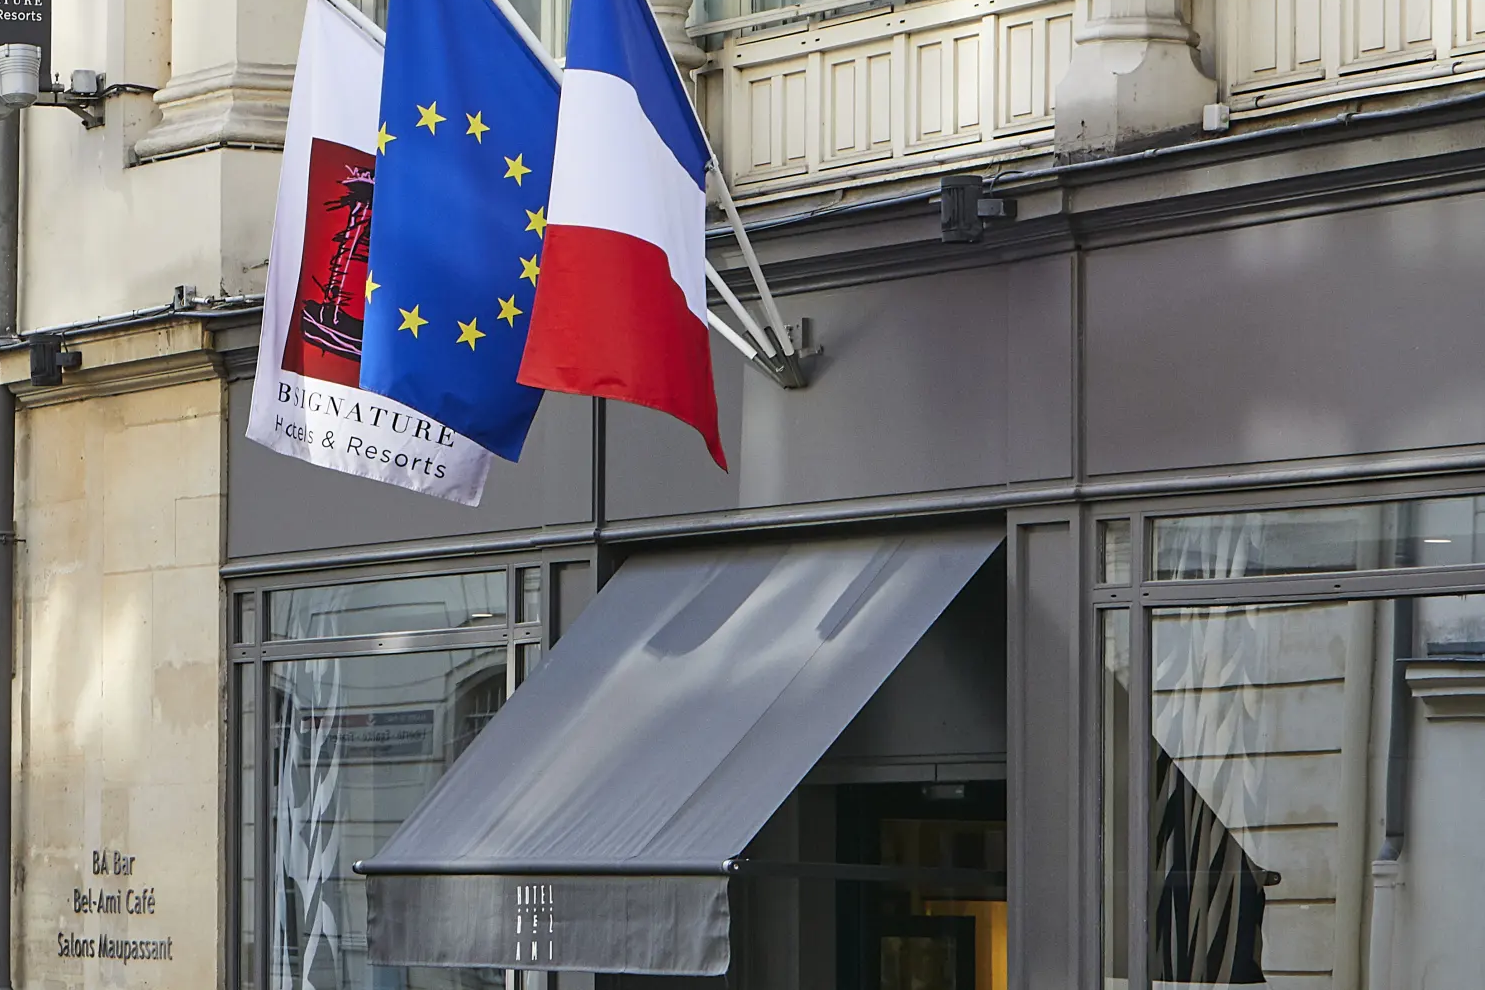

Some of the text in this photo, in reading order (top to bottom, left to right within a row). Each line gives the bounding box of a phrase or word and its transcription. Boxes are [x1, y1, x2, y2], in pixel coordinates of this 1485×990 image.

[274, 413, 447, 479] Hotels & Resorts
[92, 849, 136, 876] BA Bar
[73, 887, 156, 914] Bel-Ami Café
[517, 884, 553, 905] HOTEL
[57, 931, 173, 966] Salons Maupassant
[515, 940, 553, 961] AMI
